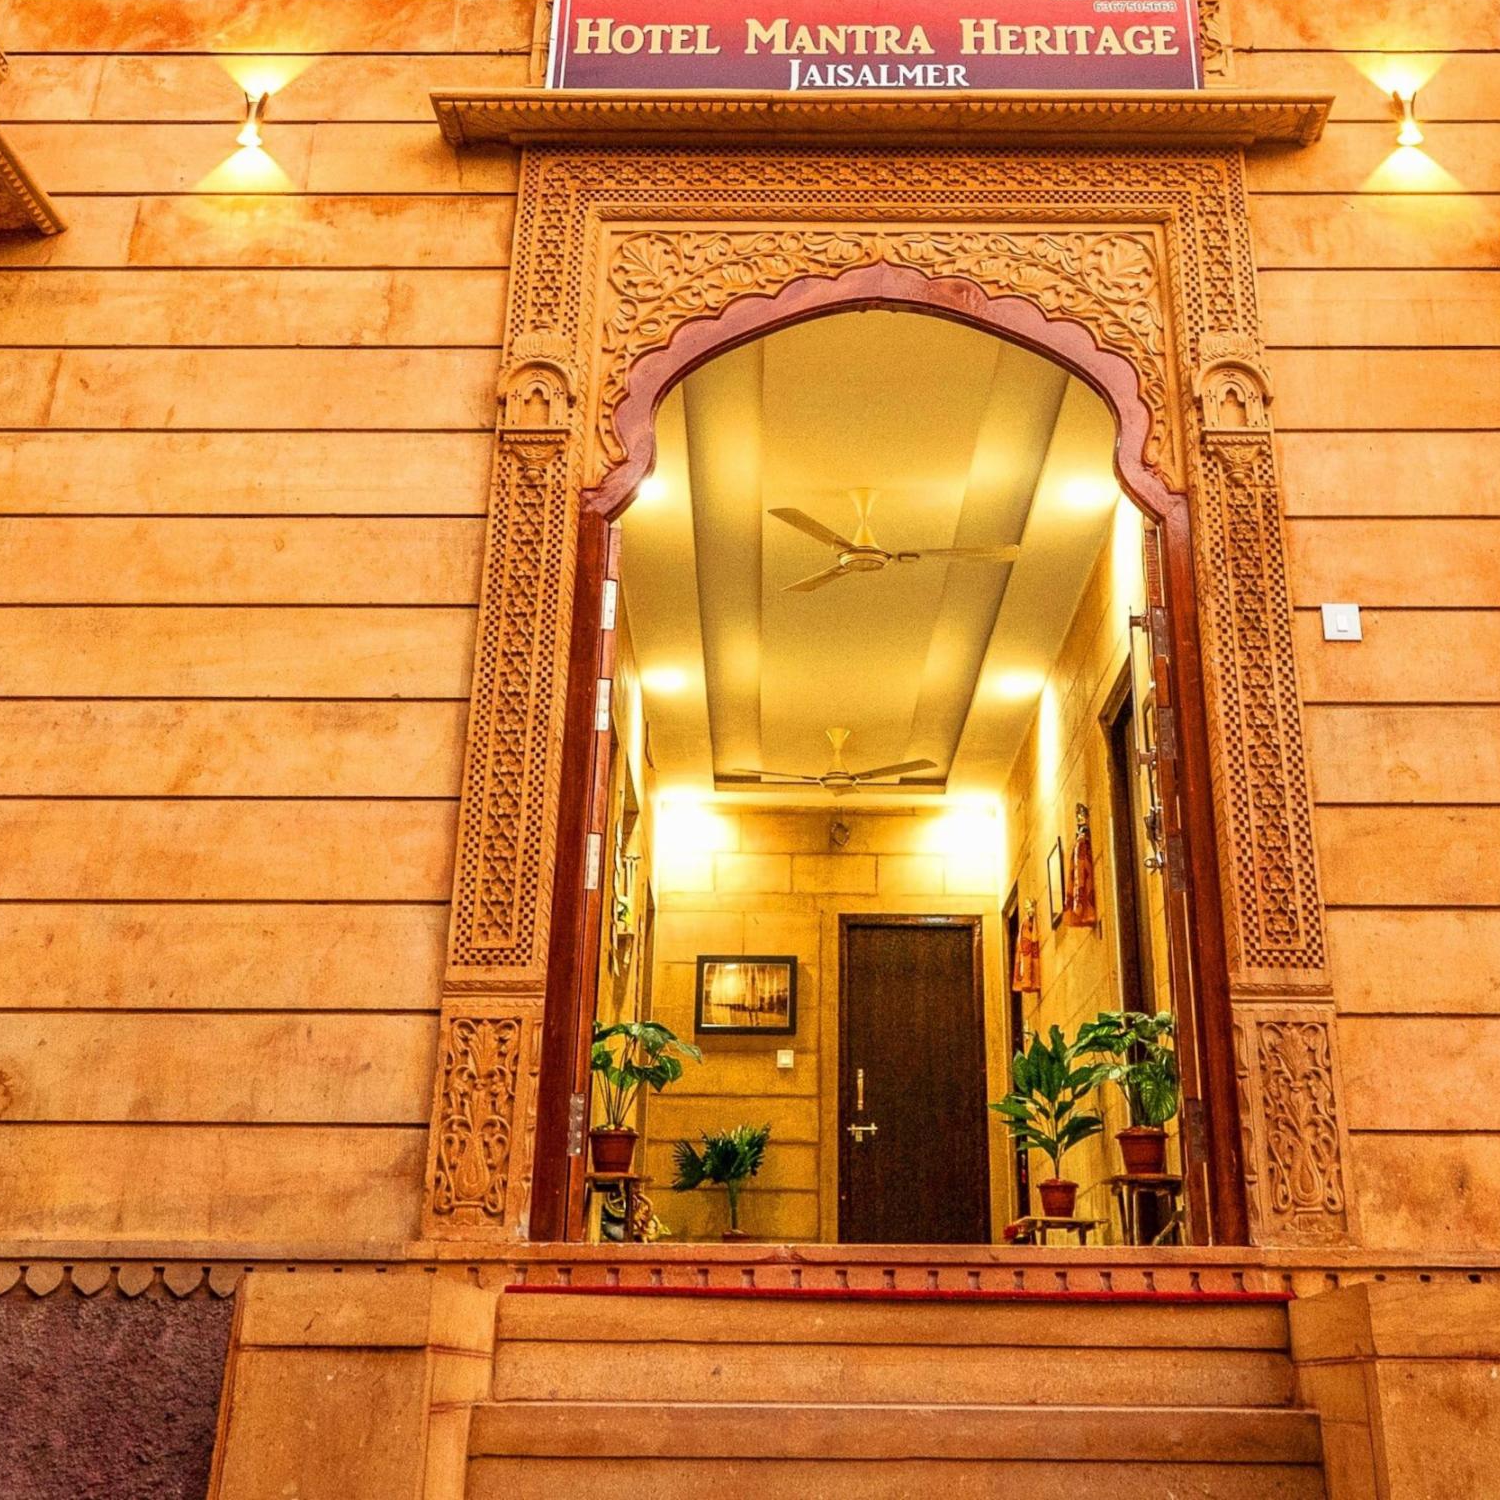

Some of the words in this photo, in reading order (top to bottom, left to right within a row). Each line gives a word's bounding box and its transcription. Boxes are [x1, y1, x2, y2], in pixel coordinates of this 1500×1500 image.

[574, 18, 721, 55] HOTEL
[745, 18, 934, 55] MANTRA
[960, 18, 1179, 55] HERITAGE
[789, 59, 969, 91] JAISALMER
